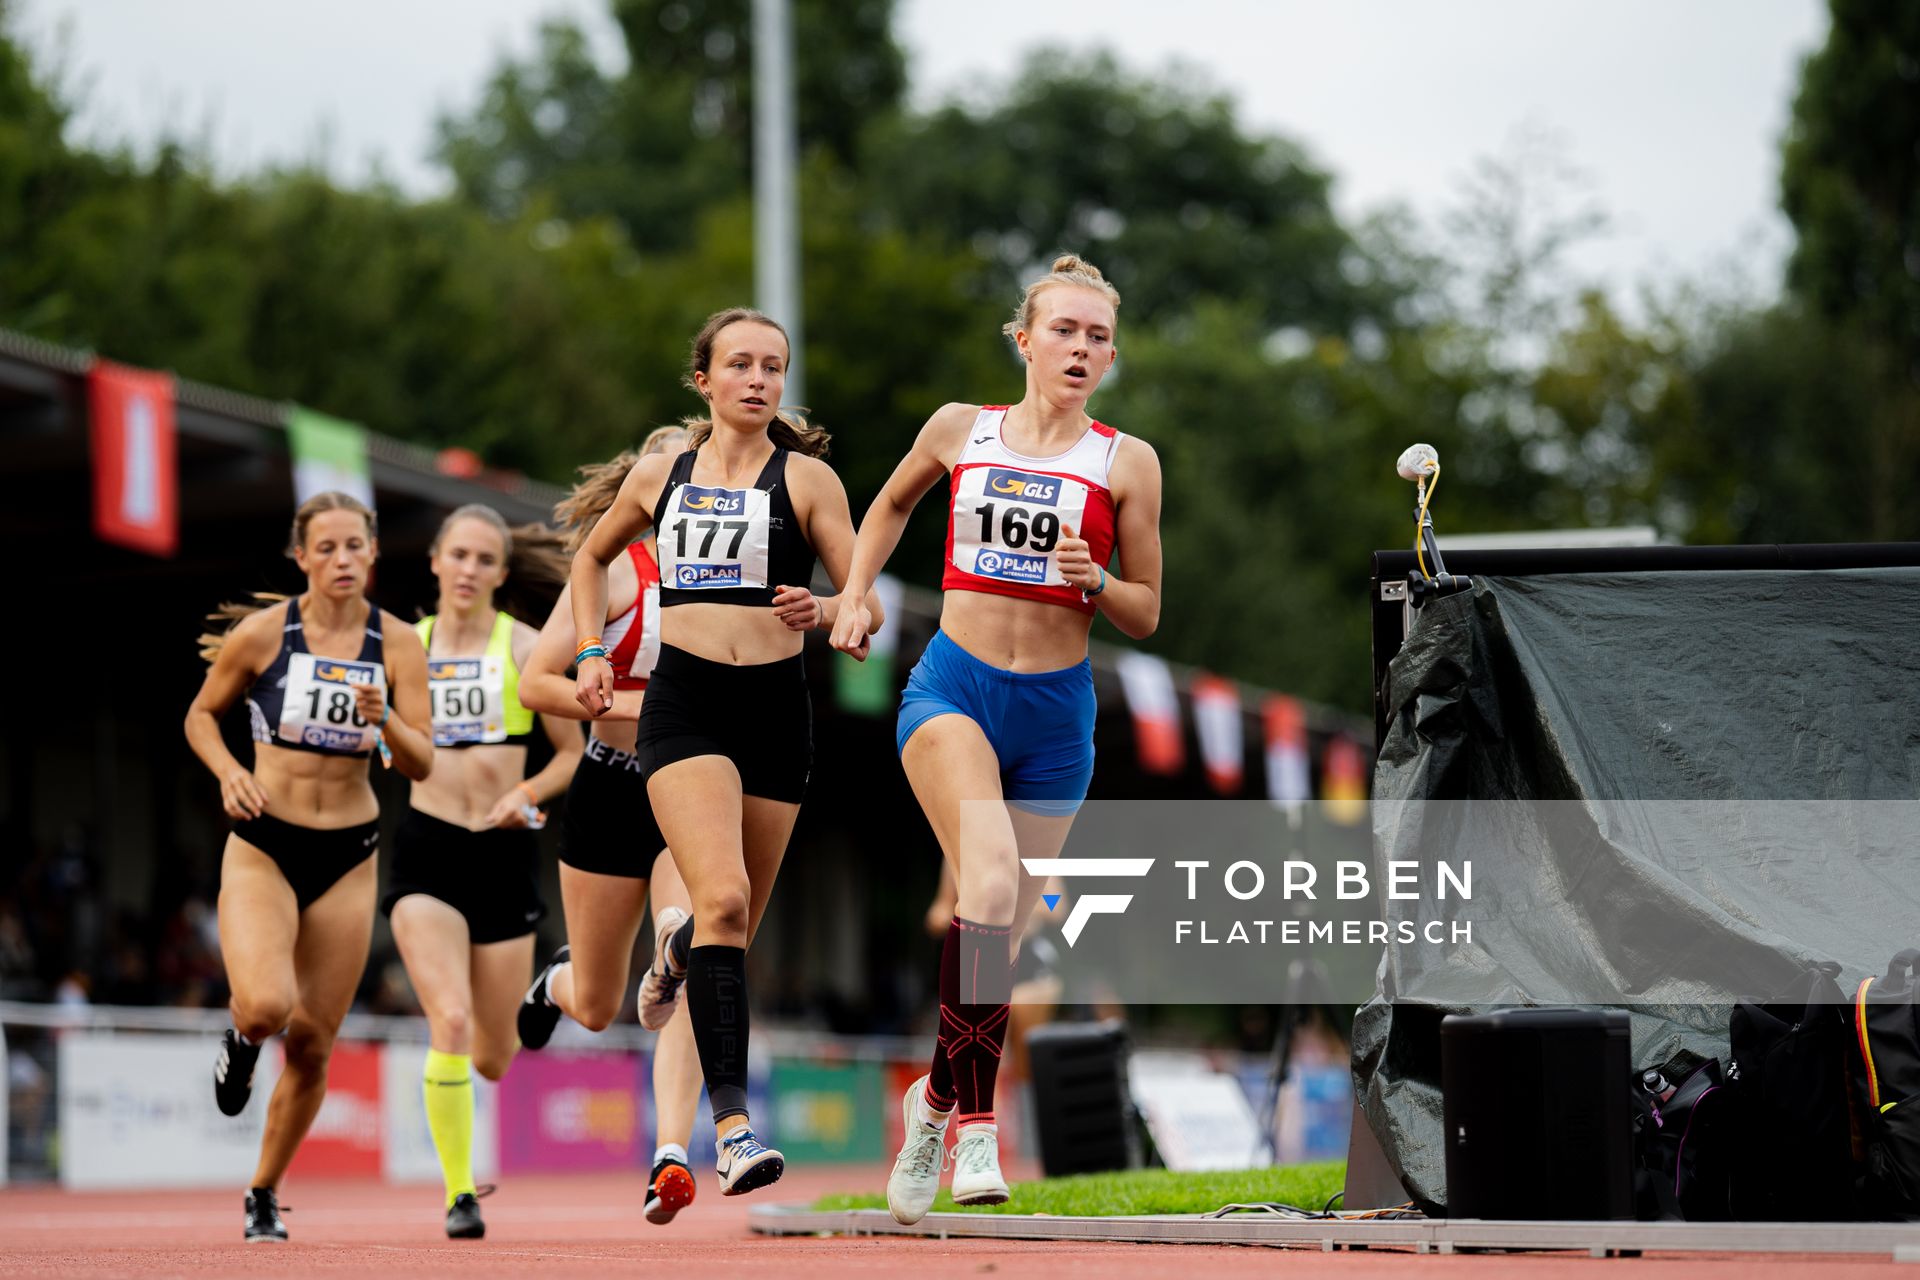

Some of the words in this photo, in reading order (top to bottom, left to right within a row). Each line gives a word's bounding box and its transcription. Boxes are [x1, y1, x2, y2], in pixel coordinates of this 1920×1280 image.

[1023, 482, 1055, 500] GLS
[714, 496, 740, 512] GLS
[975, 502, 1060, 553] 169
[672, 518, 749, 560] 177
[700, 568, 738, 579] PLAN
[1003, 557, 1044, 573] PLAN
[1002, 570, 1043, 580] INTERNATIONAL
[585, 736, 609, 762] KE
[607, 748, 641, 773] PR
